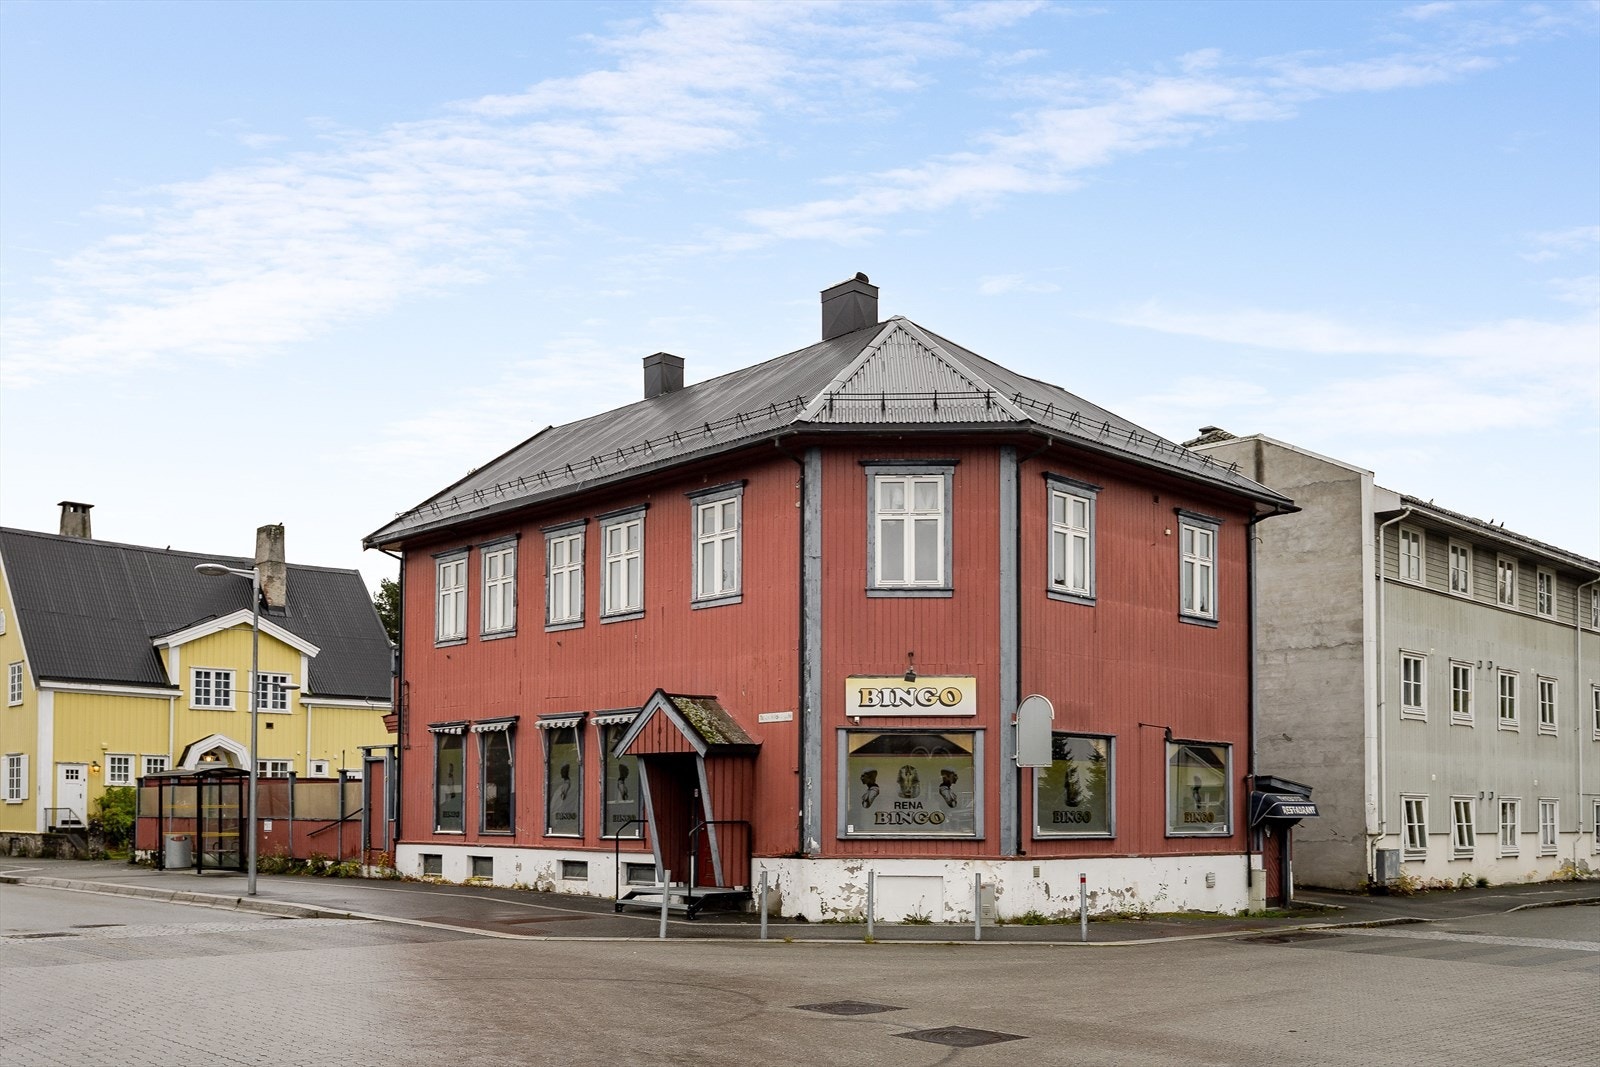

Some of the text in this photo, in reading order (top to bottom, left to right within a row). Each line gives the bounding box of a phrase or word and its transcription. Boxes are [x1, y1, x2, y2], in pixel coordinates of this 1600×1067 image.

[858, 687, 962, 708] BINGO
[894, 801, 924, 810] RENA
[1281, 805, 1317, 815] RESTAURANT
[874, 811, 946, 825] BINGO
[1052, 810, 1092, 823] BINGO
[1184, 811, 1215, 823] BINGO
